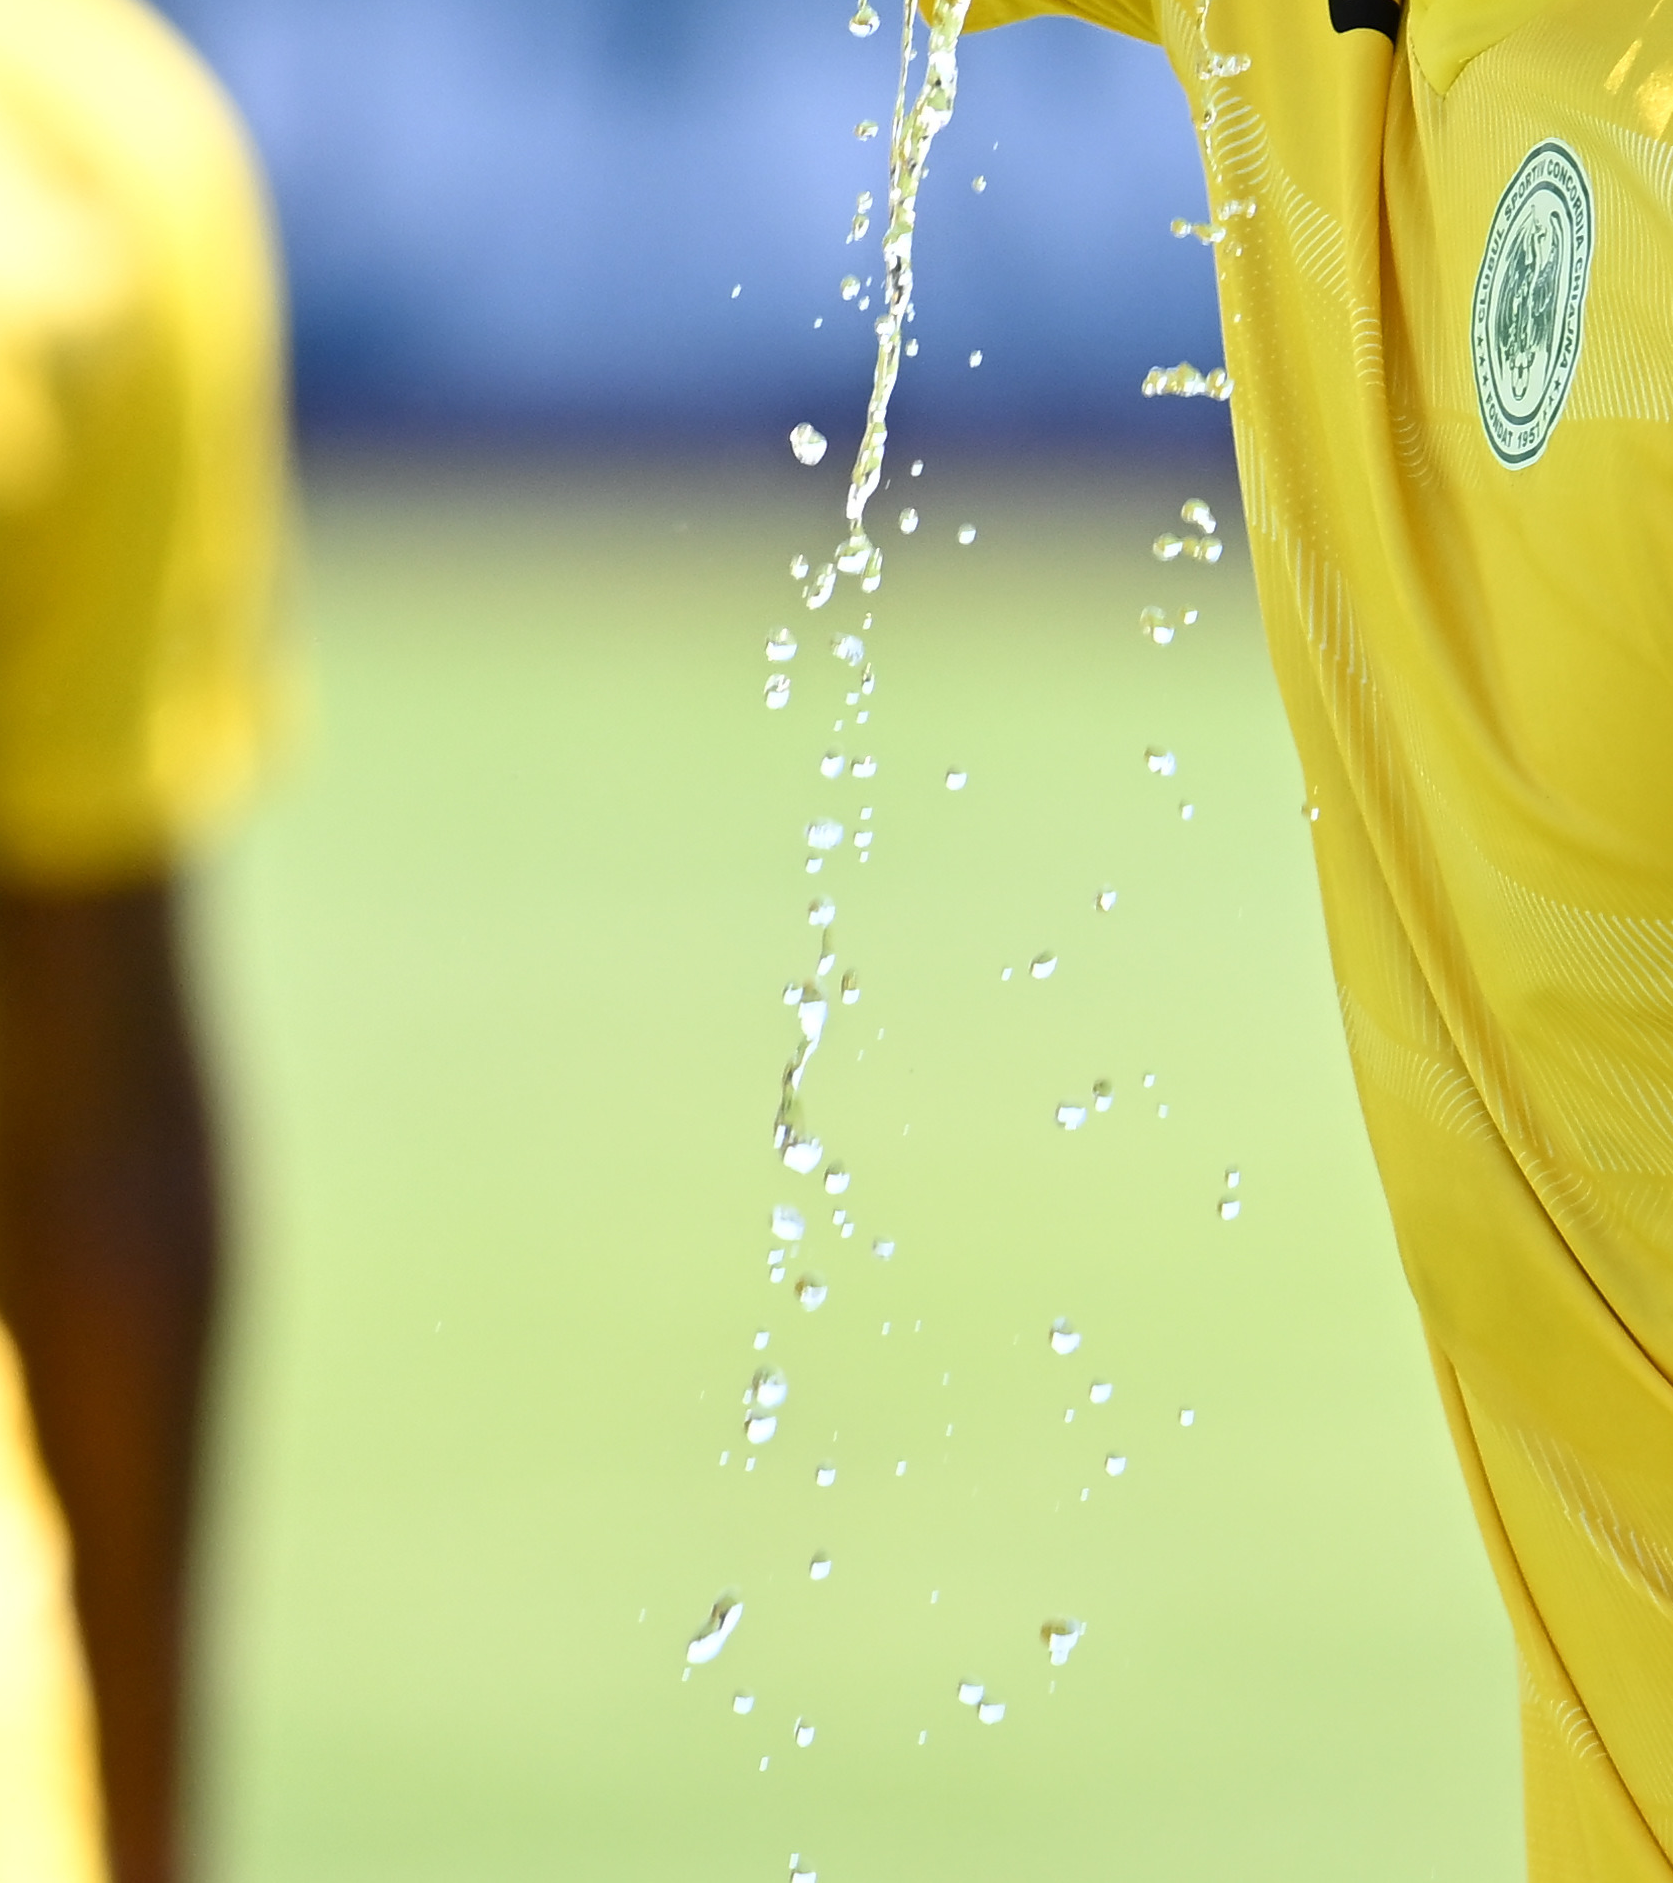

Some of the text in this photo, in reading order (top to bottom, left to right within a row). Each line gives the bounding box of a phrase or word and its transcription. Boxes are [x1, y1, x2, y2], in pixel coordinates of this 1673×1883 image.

[1478, 159, 1584, 368] CLUBUL SPORTIV CONCORDIA CHIAJNA
[1486, 391, 1540, 449] FONDAT 1957
